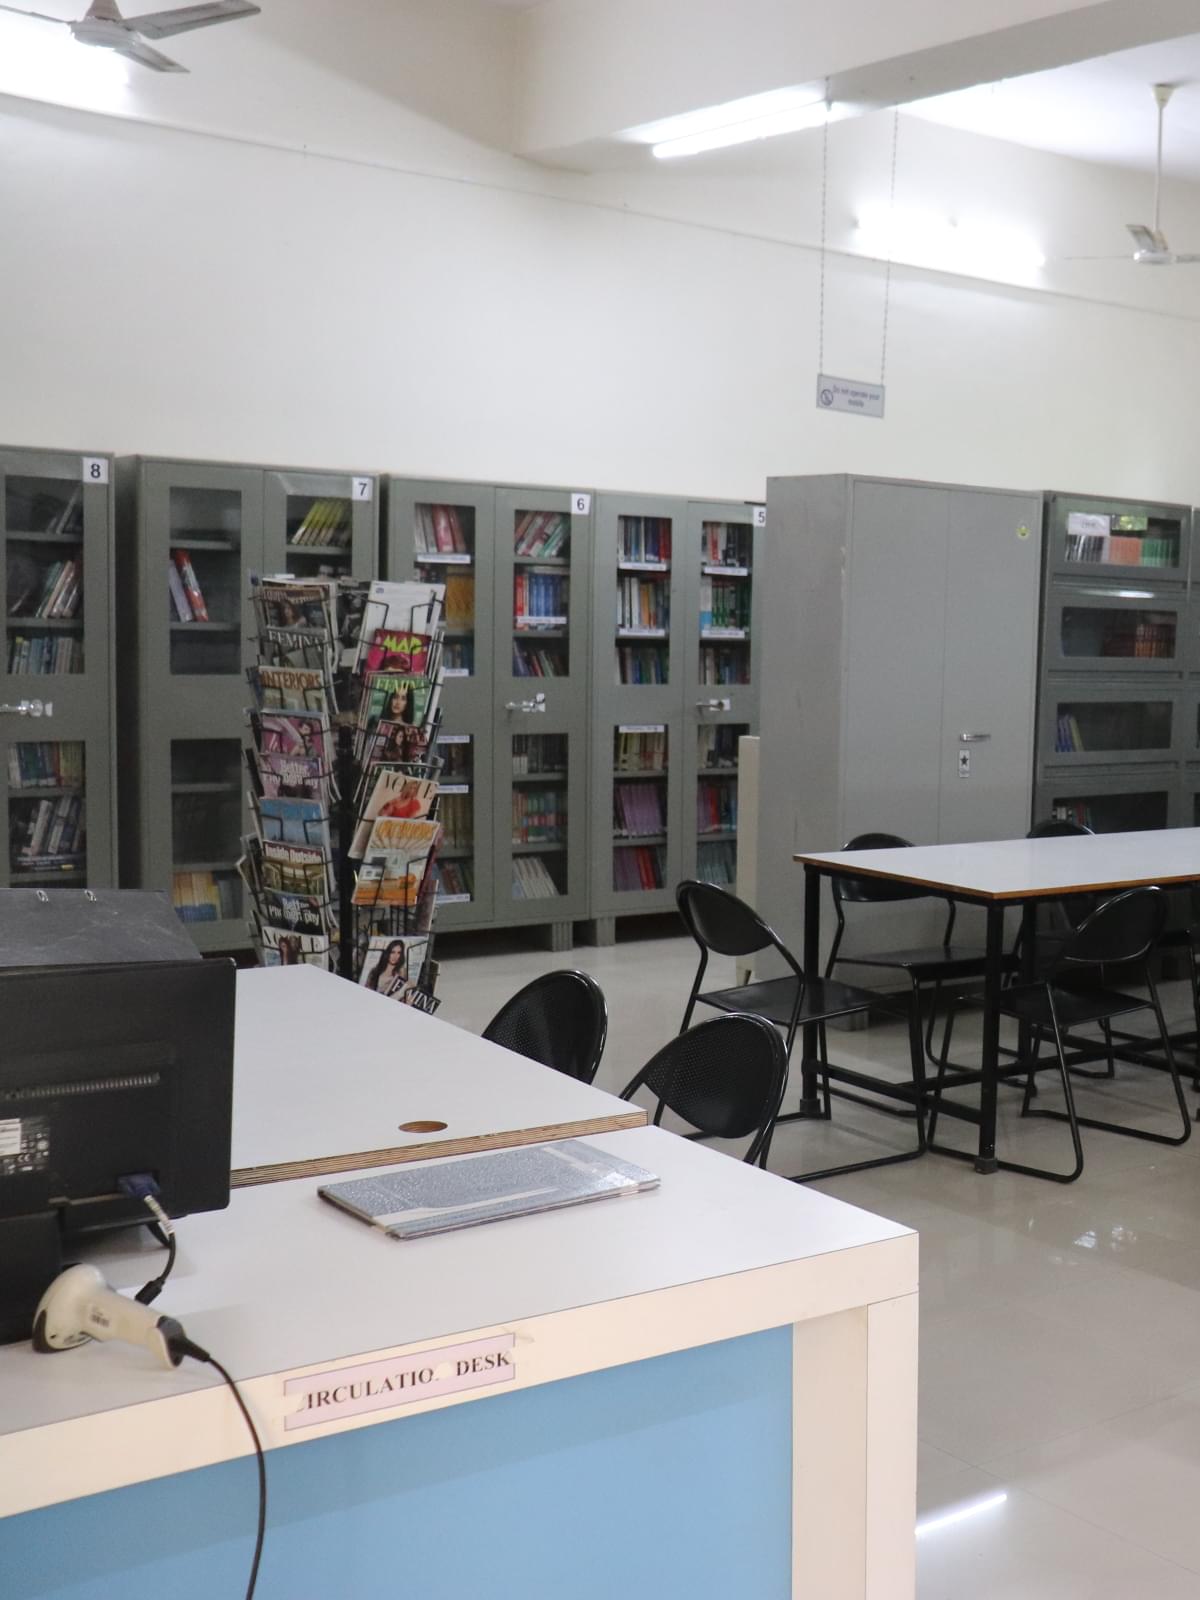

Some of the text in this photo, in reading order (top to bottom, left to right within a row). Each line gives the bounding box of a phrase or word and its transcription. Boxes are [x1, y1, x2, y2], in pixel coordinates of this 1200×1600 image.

[90, 463, 101, 479] 8
[358, 482, 368, 497] 7
[576, 497, 585, 511] 6
[758, 511, 765, 523] 5
[380, 634, 422, 656] MAD
[300, 1351, 511, 1411] IRCULATIO DESK
